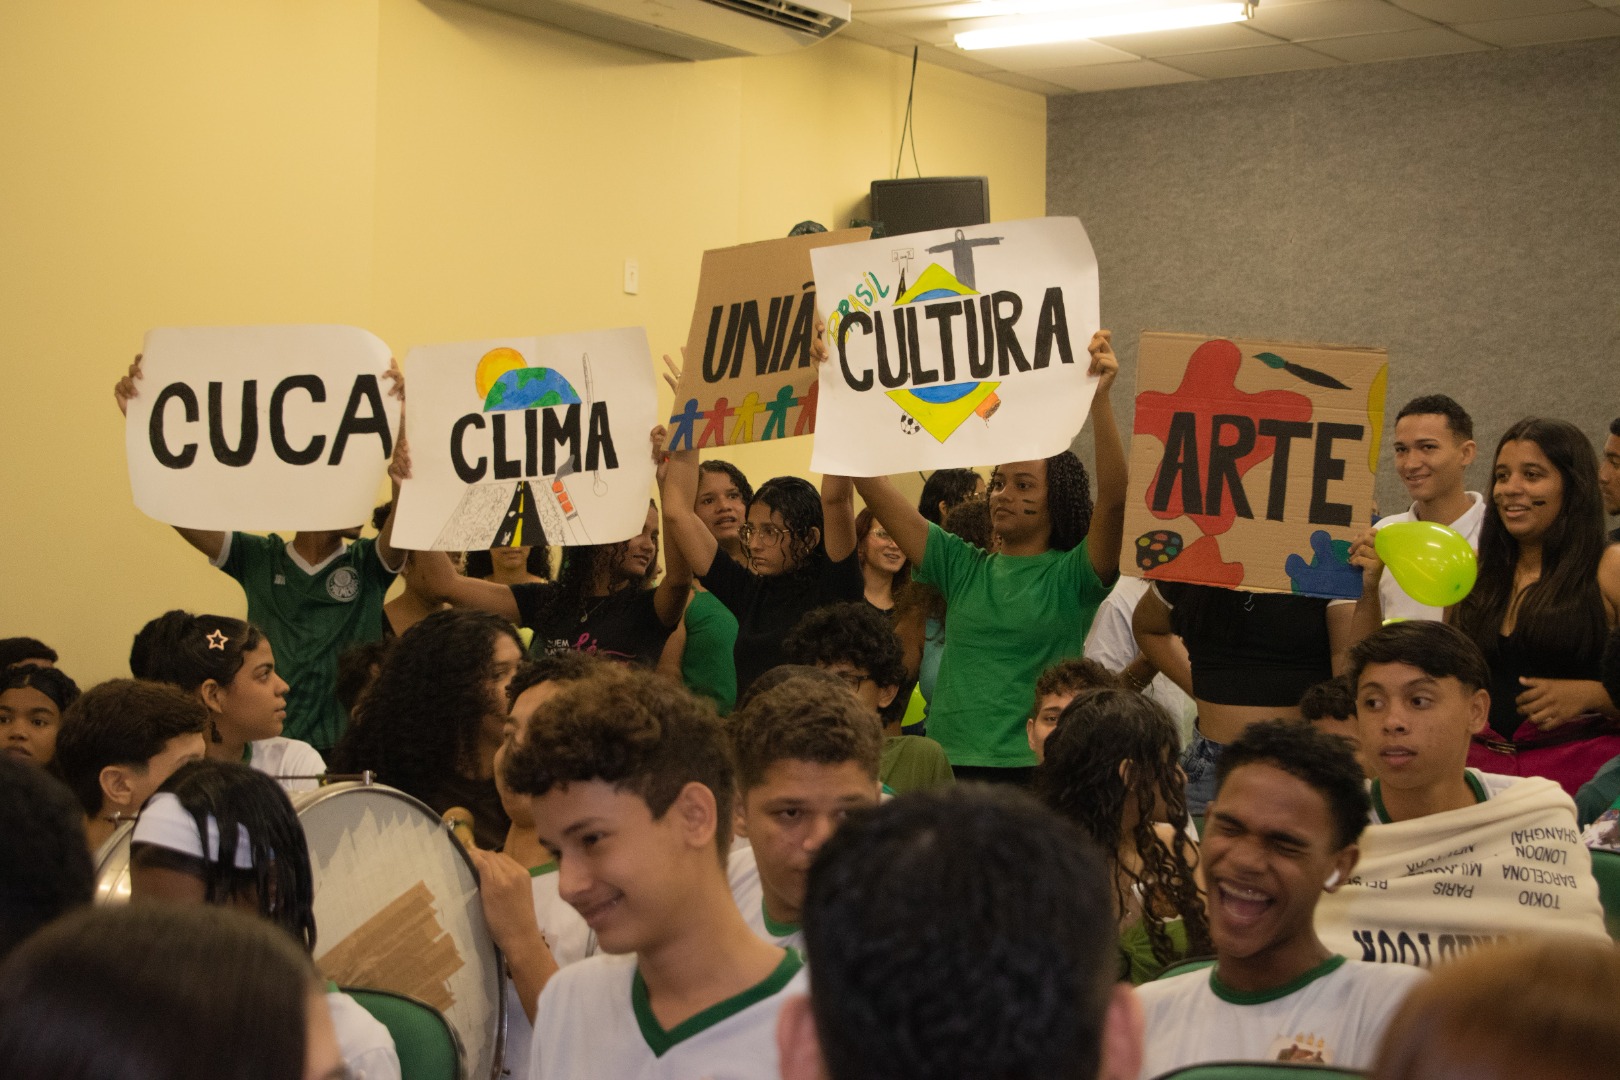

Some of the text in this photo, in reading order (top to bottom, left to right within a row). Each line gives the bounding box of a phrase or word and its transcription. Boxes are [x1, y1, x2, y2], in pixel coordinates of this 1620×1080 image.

[702, 281, 816, 383] UNIÃ
[837, 286, 1075, 392] CULTURA
[149, 373, 392, 469] CUCA
[450, 401, 619, 483] CLIMA
[1152, 411, 1364, 527] ARTE
[1511, 827, 1578, 846] SHANGHAI
[1515, 845, 1568, 865] LONDON
[1432, 881, 1474, 899] PARIS
[1501, 864, 1578, 889] BARCELONA
[1518, 890, 1561, 910] TOKIO
